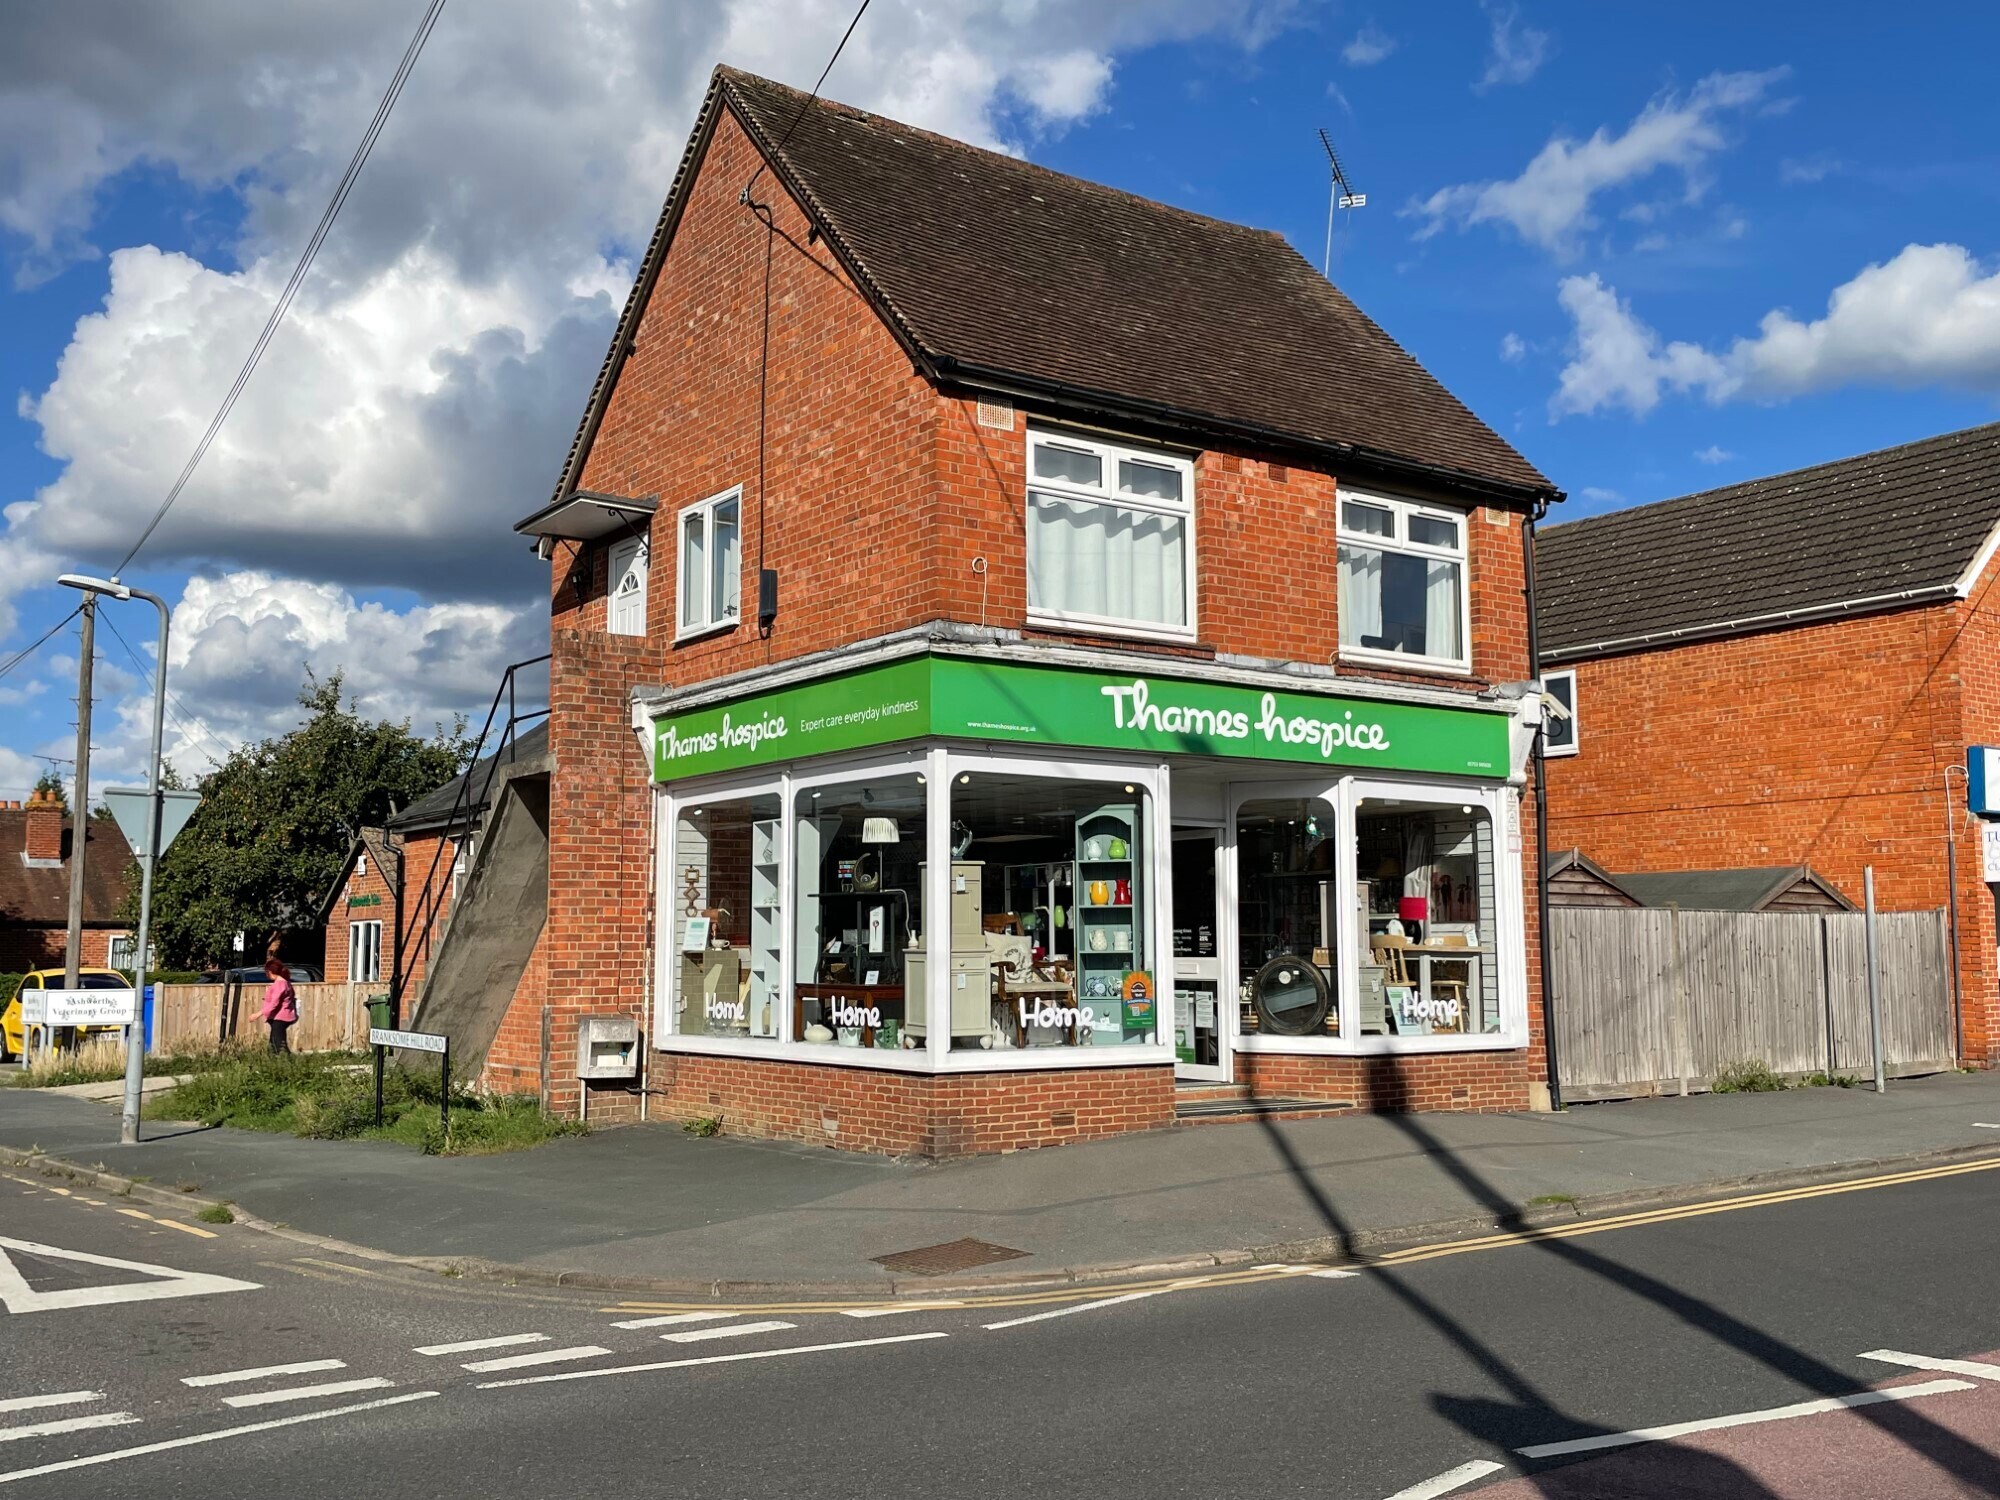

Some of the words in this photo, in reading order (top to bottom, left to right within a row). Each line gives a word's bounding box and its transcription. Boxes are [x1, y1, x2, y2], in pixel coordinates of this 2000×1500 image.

[800, 718, 825, 733] Expert
[826, 715, 842, 727] care
[844, 707, 880, 724] everyday
[882, 700, 919, 716] kindness
[1101, 679, 1249, 738] Thames
[1253, 693, 1390, 757] hospice
[659, 725, 717, 760] Thames
[719, 711, 788, 752] hospice
[705, 992, 745, 1020] Home
[831, 995, 882, 1028] Home
[1019, 996, 1095, 1028] Home
[1402, 990, 1460, 1018] Home
[371, 1030, 409, 1046] BRANKSOME
[410, 1035, 424, 1048] HILL
[424, 1037, 444, 1050] ROAD
